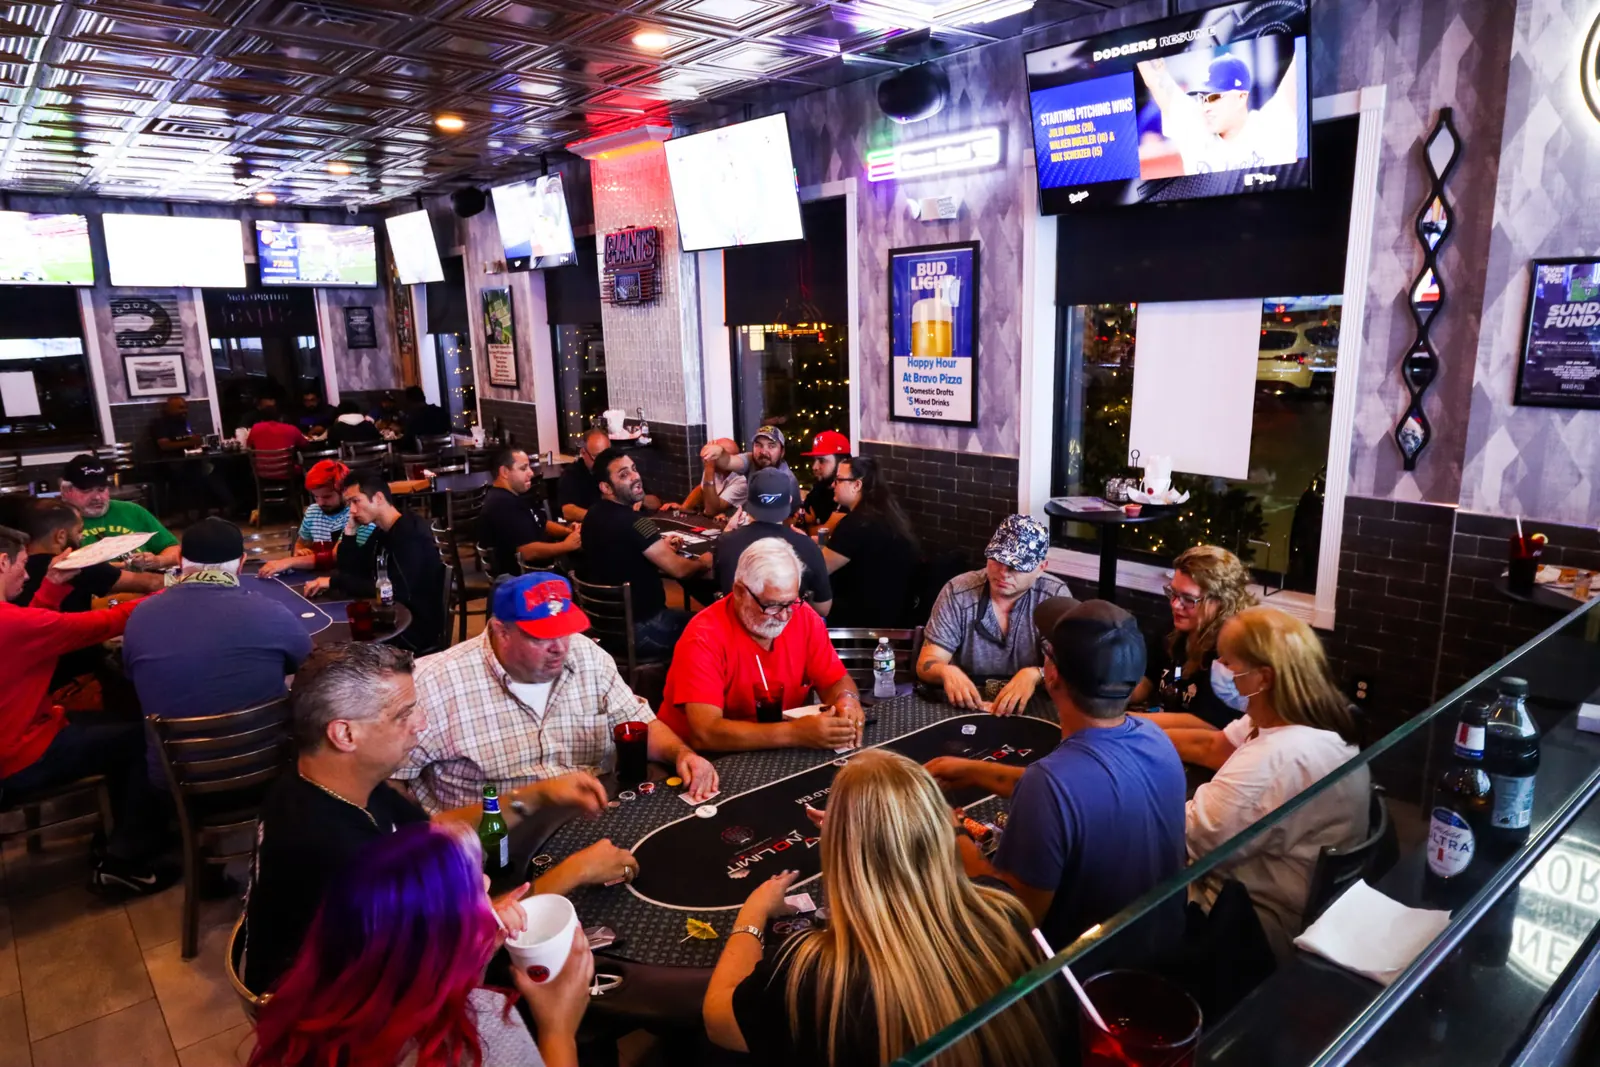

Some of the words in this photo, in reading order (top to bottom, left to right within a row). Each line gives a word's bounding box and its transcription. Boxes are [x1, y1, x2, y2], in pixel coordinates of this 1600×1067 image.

[1092, 38, 1157, 62] DODGERS
[1041, 109, 1075, 126] STARTING
[1075, 102, 1112, 120] PITCHING
[1111, 97, 1134, 114] WINS
[605, 229, 656, 265] GIANTS
[916, 261, 948, 277] BUD
[115, 302, 157, 314] GOOSE
[1548, 302, 1600, 317] SUND
[907, 357, 934, 370] Happy
[936, 357, 957, 368] Hour
[903, 372, 912, 382] At
[913, 372, 938, 384] Bravo
[939, 373, 962, 385] Pizza
[910, 387, 935, 395] Domestic
[936, 388, 954, 396] Drafts
[914, 397, 931, 406] Mixed
[931, 398, 949, 407] Drinks
[921, 408, 943, 418] Sangria
[795, 788, 831, 804] OLD'EM
